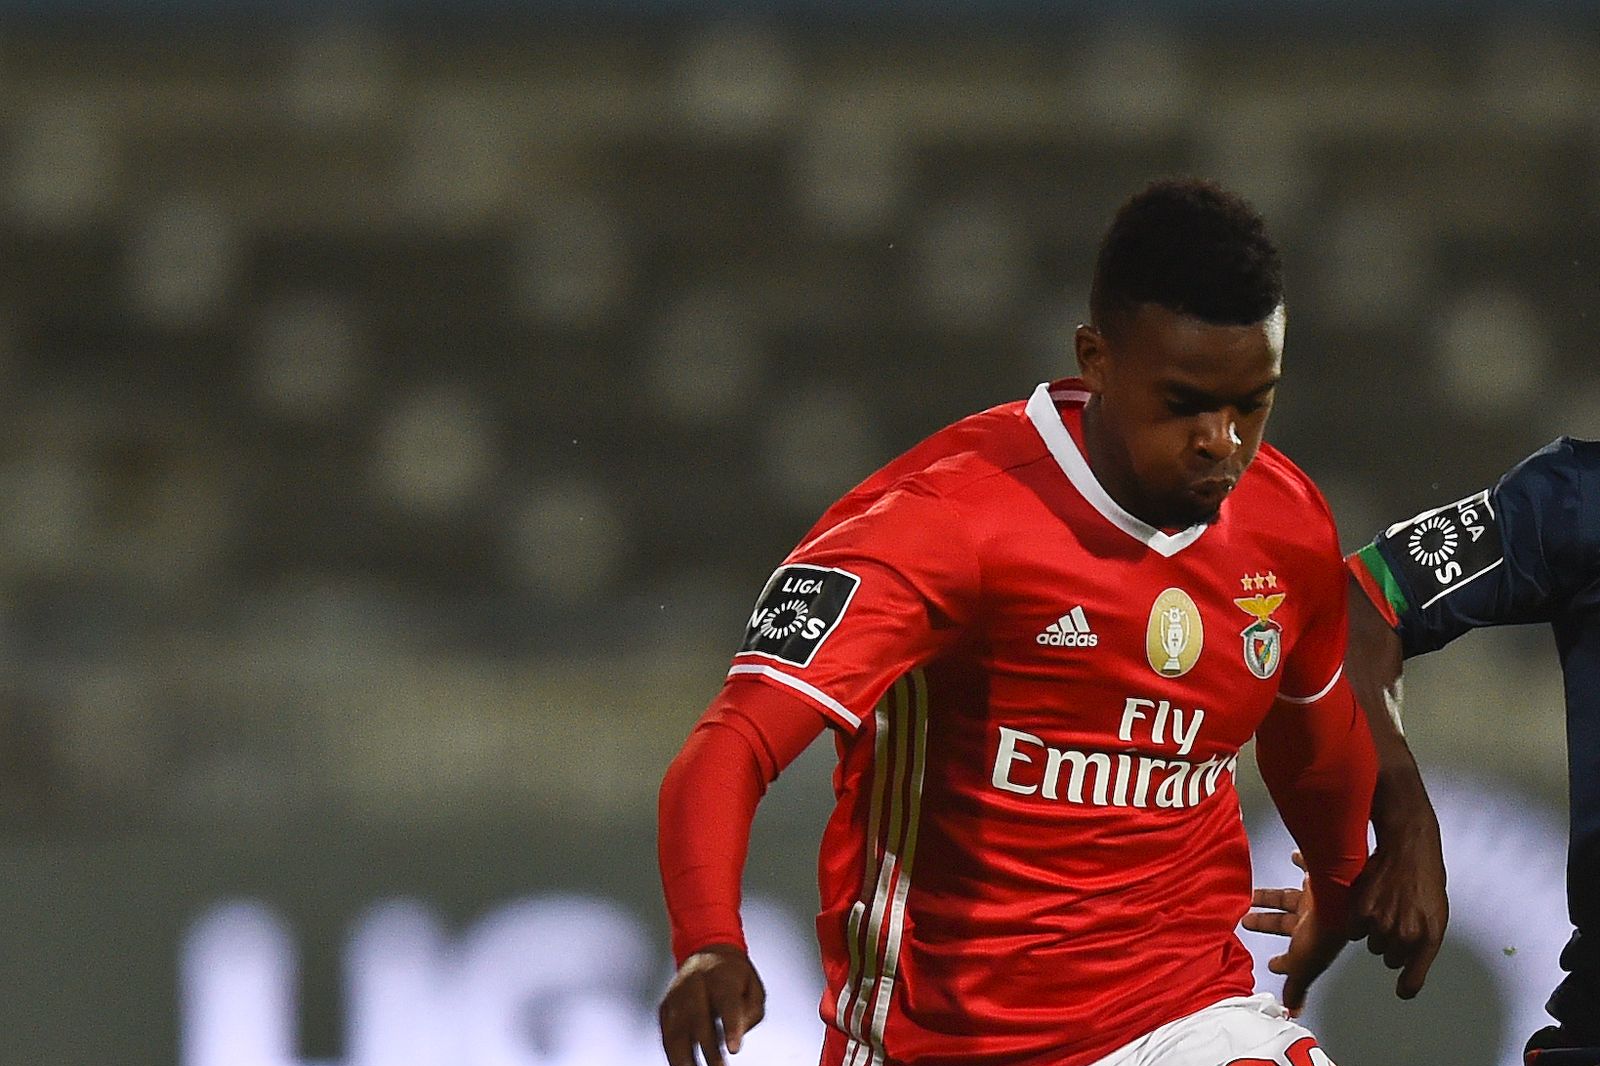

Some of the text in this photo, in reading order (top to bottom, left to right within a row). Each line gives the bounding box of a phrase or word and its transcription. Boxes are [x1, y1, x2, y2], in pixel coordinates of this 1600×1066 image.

[782, 577, 823, 594] LIGA
[1036, 631, 1098, 647] adidas
[1119, 698, 1204, 755] Fly
